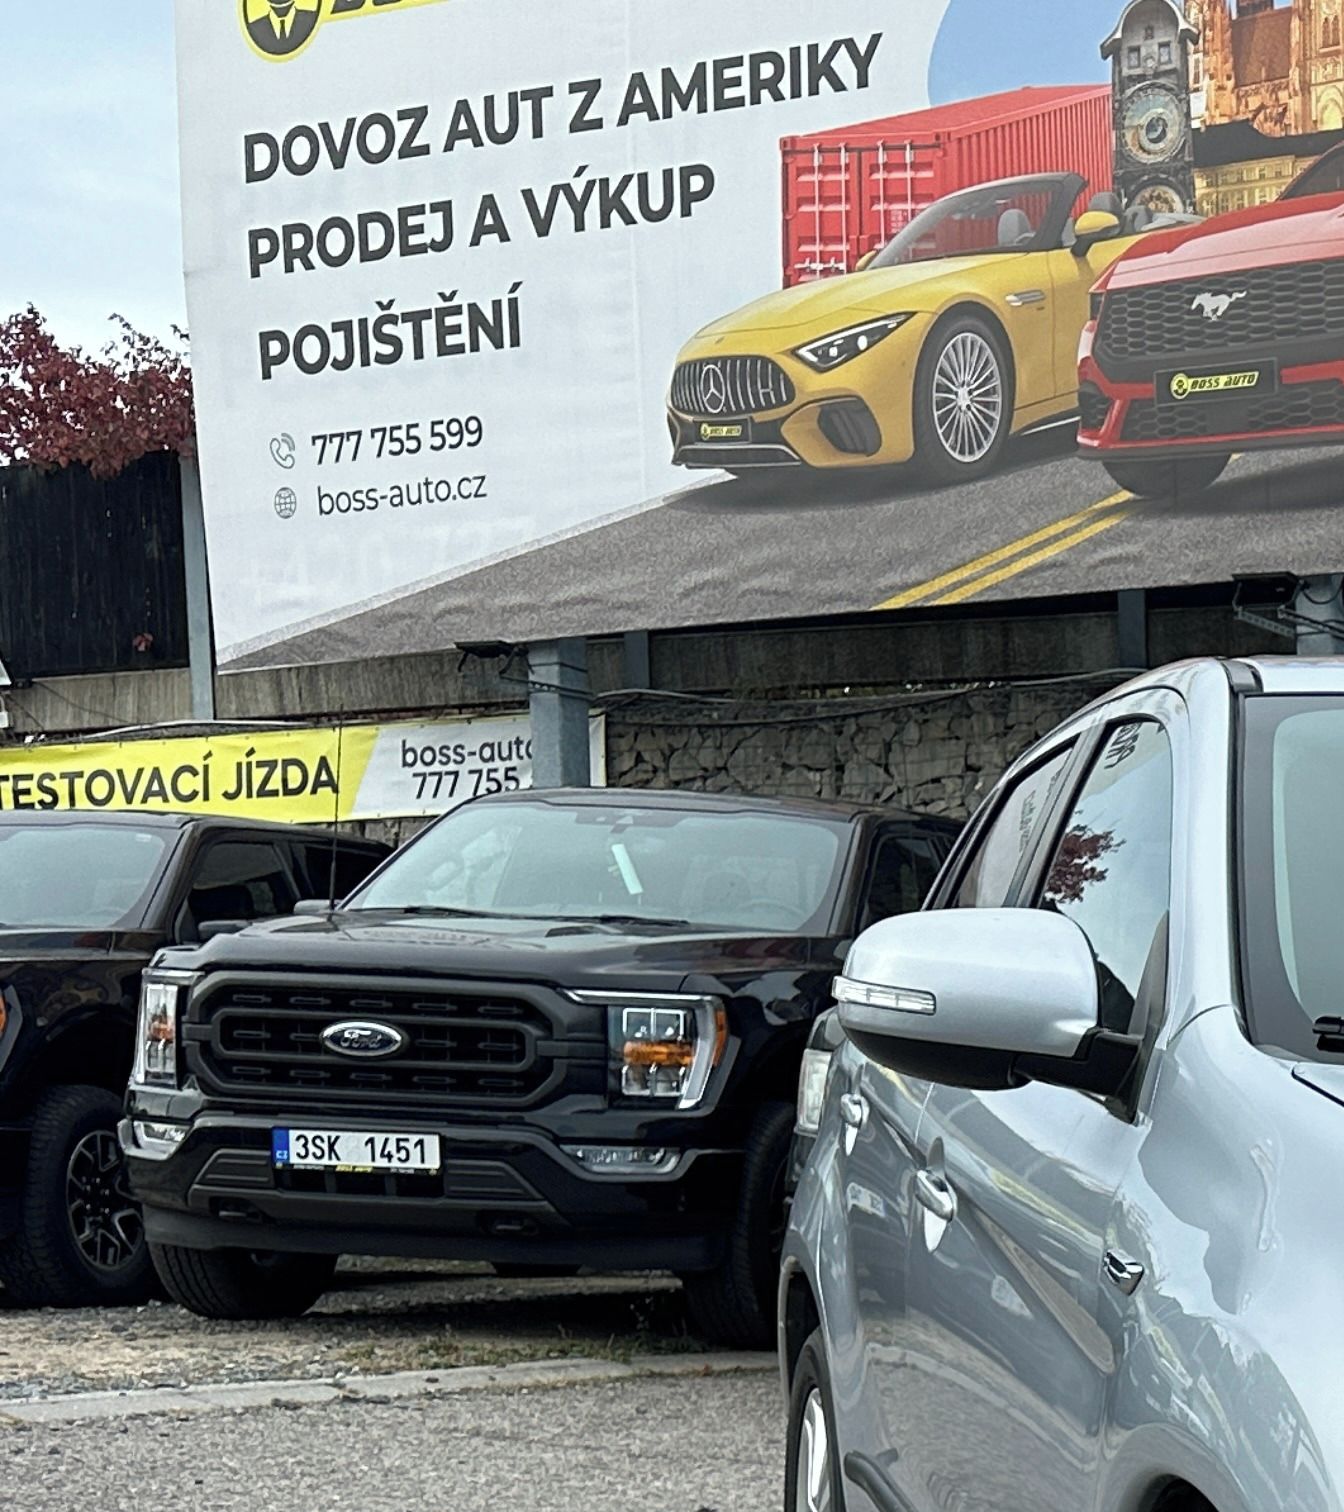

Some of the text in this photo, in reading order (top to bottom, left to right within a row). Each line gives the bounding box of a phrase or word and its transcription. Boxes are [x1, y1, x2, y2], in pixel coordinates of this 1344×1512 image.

[244, 32, 883, 184] DOVOZ AUT Z AMERIKY
[248, 164, 715, 279] PRODEJ A VÝKUP
[258, 281, 523, 381] POJIŠTĚNÍ
[1190, 378, 1220, 390] BOSS
[311, 415, 484, 466] 777 755 599
[317, 474, 488, 516] boss-auto.cz
[221, 747, 338, 801] JÍZDA
[412, 766, 521, 800] 777 755
[295, 1134, 426, 1165] 3SK 1451
